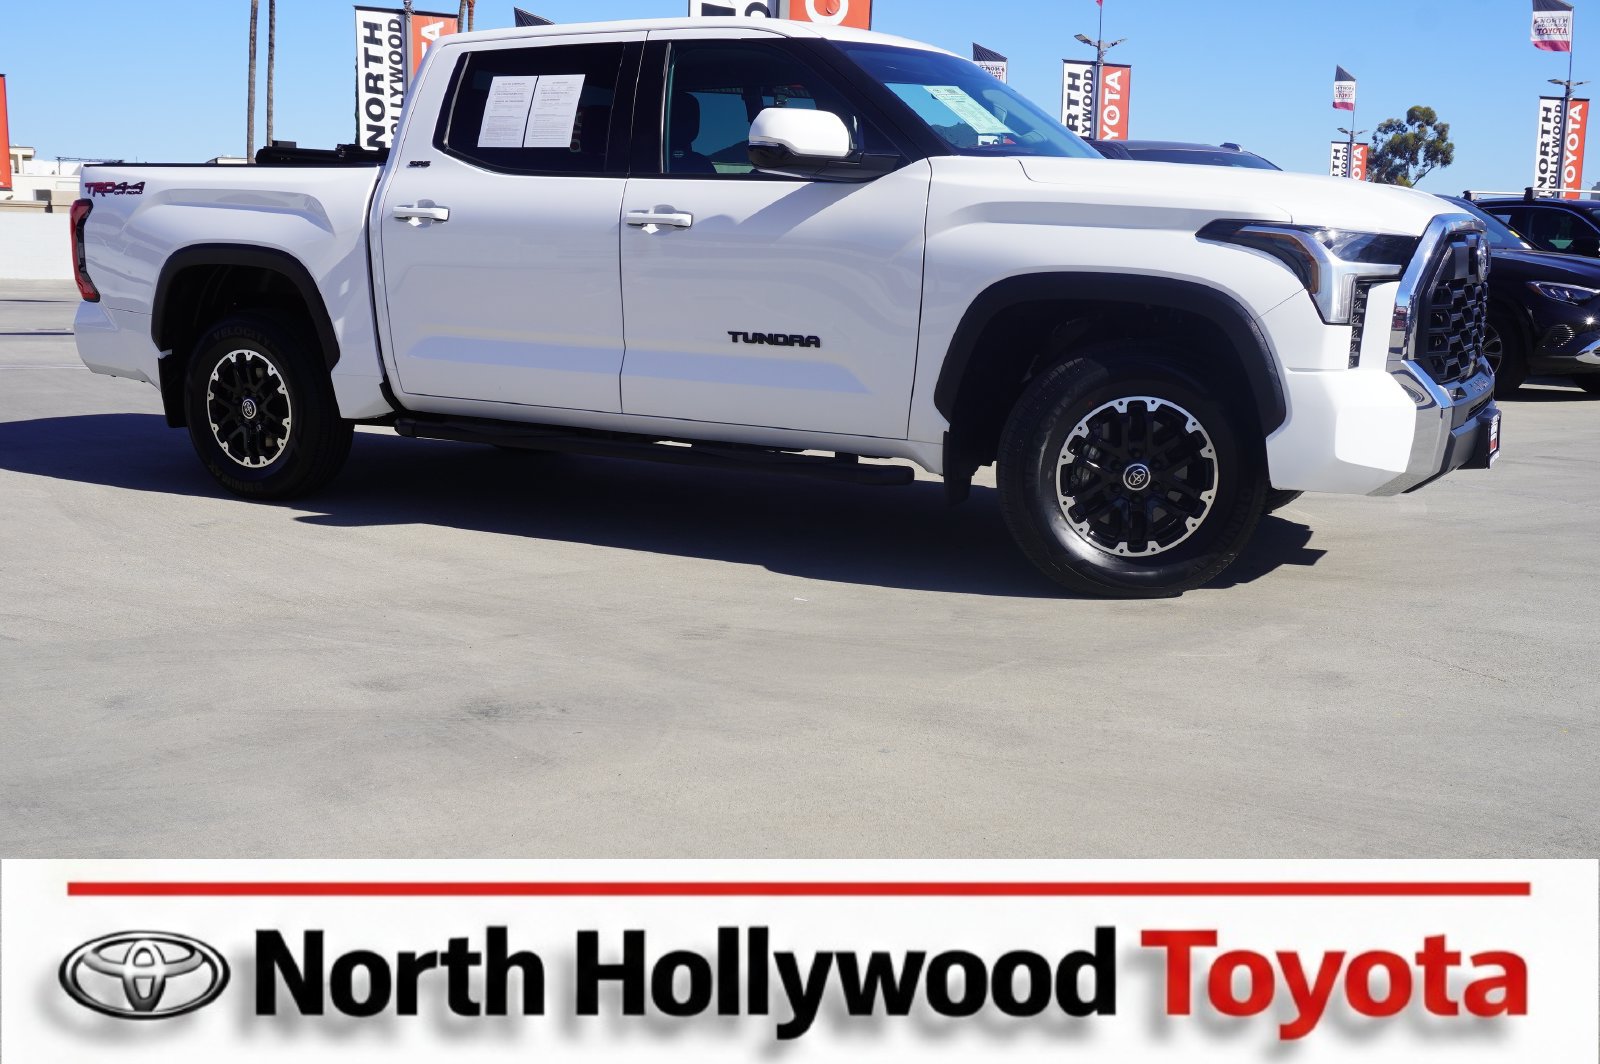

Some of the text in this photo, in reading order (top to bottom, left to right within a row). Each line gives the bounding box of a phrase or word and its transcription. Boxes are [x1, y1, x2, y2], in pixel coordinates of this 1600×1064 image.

[363, 21, 386, 148] NORTH
[388, 18, 404, 141] LYWOOD
[1066, 72, 1081, 133] RTH
[1082, 69, 1094, 137] YWOOD
[1102, 70, 1122, 140] YOTA
[1352, 147, 1364, 180] OTA
[1562, 104, 1582, 198] TOYOTA
[85, 182, 116, 197] TRD
[728, 331, 820, 348] TUNDRA
